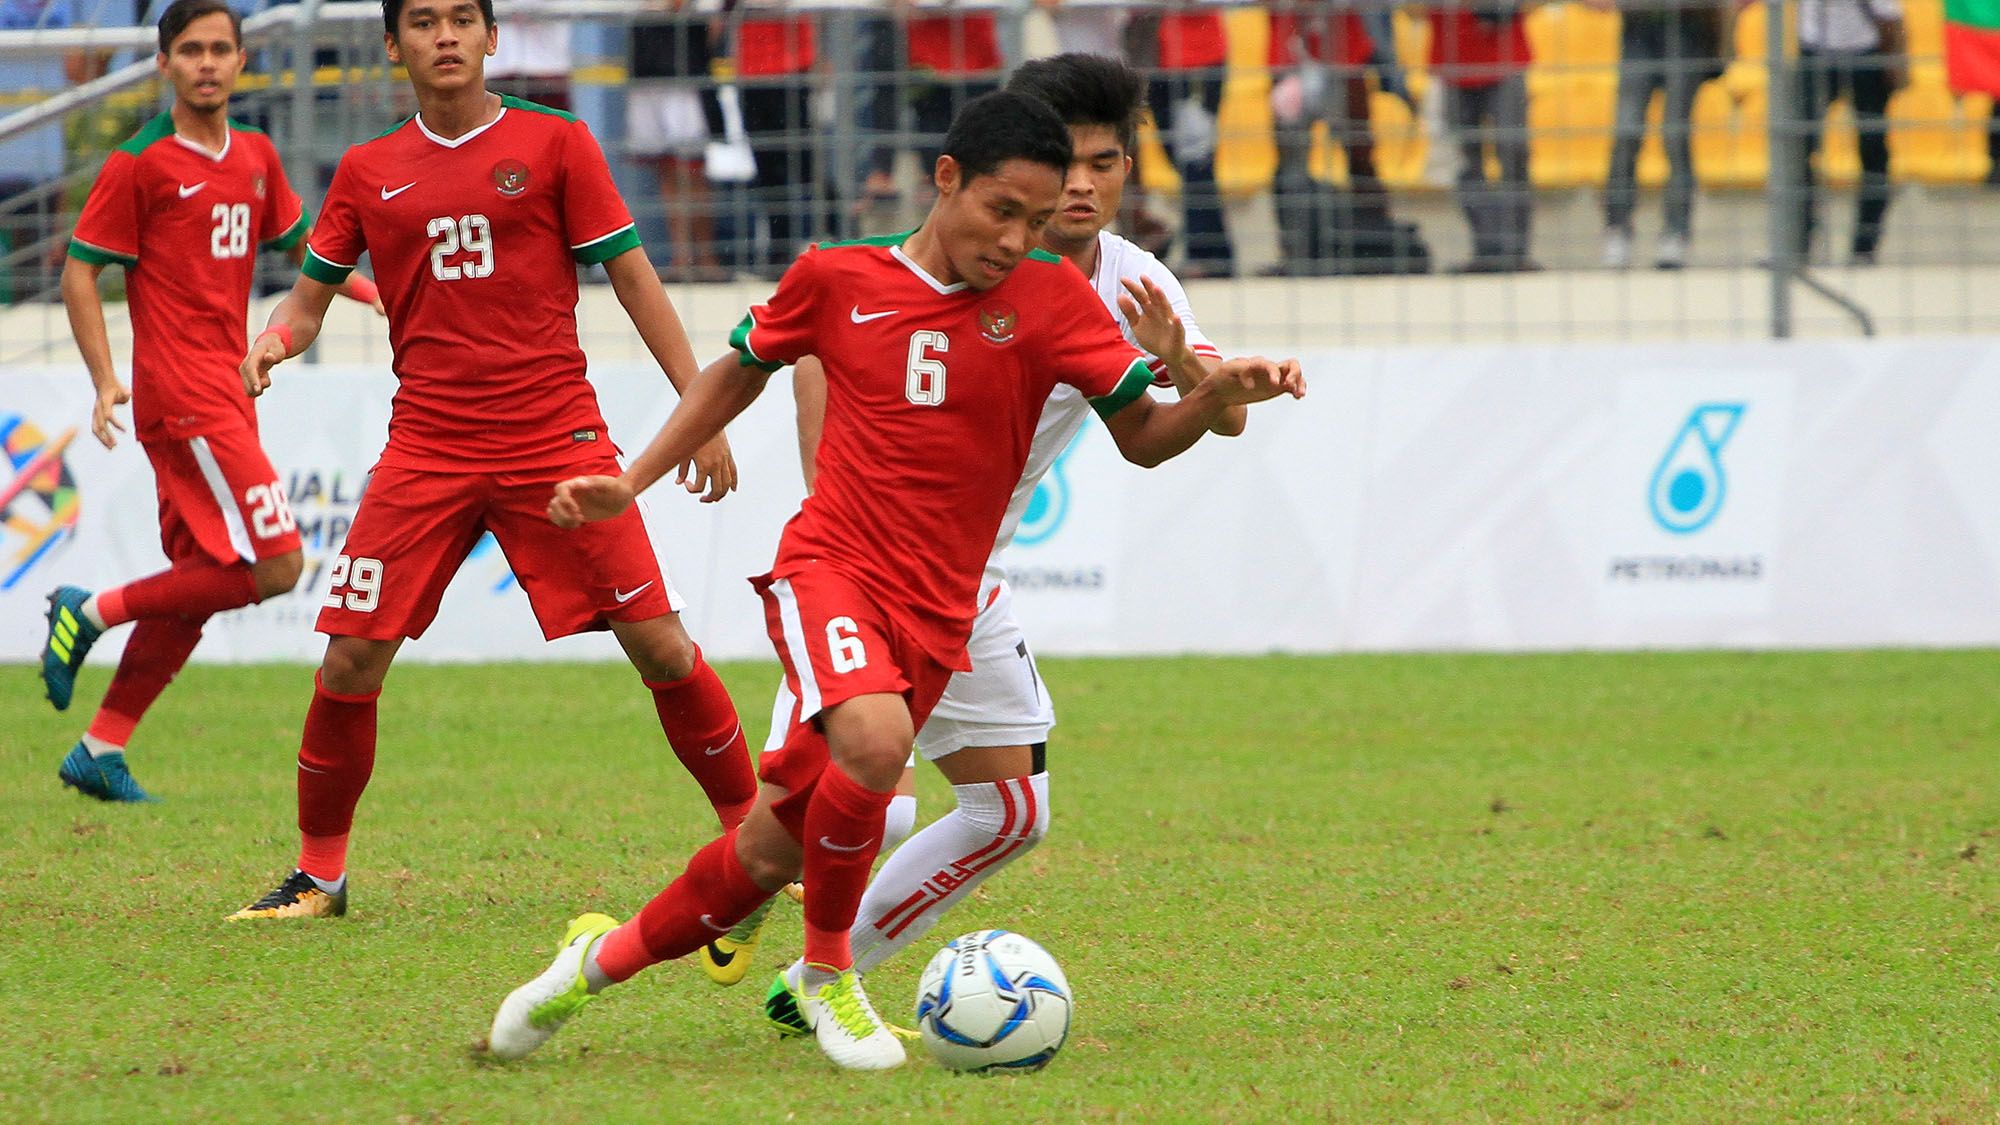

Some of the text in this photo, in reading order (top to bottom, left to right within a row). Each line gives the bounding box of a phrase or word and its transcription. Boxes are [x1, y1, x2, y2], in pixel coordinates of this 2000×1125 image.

[211, 203, 250, 258] 28
[426, 214, 494, 280] 29
[905, 330, 949, 406] 6
[245, 480, 297, 539] 28
[322, 555, 384, 612] 29
[1006, 567, 1105, 590] RONAS
[825, 616, 868, 674] 6
